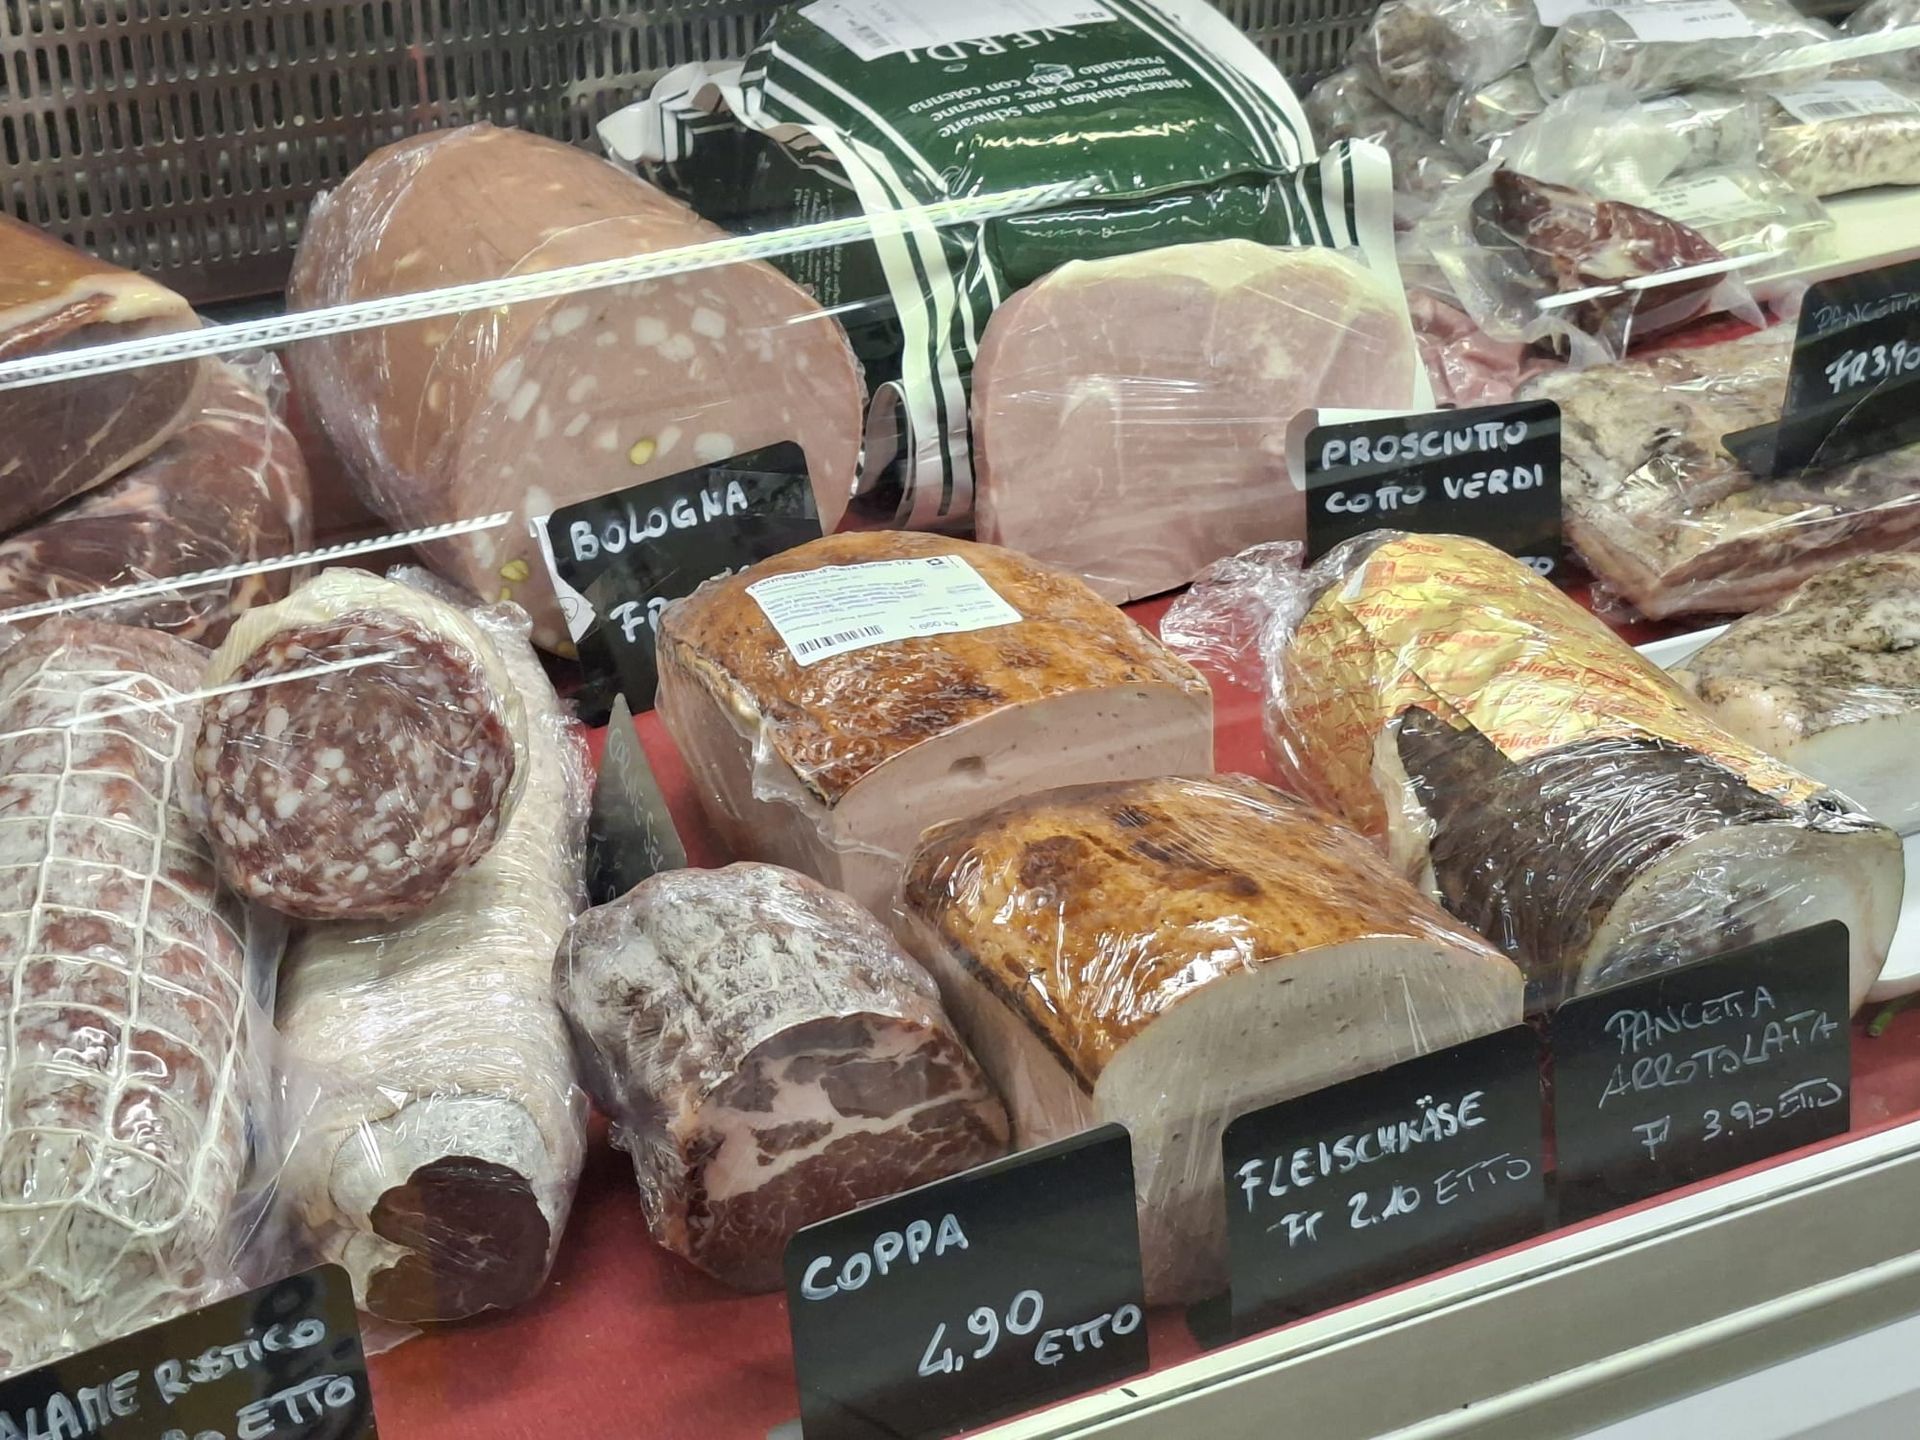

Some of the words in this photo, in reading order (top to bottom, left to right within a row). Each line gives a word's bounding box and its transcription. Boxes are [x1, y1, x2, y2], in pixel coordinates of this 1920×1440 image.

[986, 79, 1021, 92] con
[1078, 56, 1165, 75] Prosciutto
[908, 87, 982, 113] cotenna
[930, 95, 1010, 121] couenne
[1014, 87, 1057, 99] avec
[1024, 100, 1057, 113] mit
[1060, 78, 1192, 104] Hinterschinken
[938, 106, 1022, 137] Schwarte
[1321, 421, 1528, 470] PROSCIUTTO
[1325, 485, 1426, 513] COTTO
[1443, 463, 1544, 500] VERDI
[569, 481, 749, 562] BOLOGNA
[1604, 986, 1776, 1054] PANCETTA
[1234, 1090, 1487, 1213] FLEISCHKÄSE
[1434, 1153, 1531, 1205] ETTO
[801, 1213, 969, 1300] COPPA
[1034, 1303, 1142, 1366] ETTO
[0, 1369, 140, 1440] ALAME
[236, 1374, 356, 1440] ETTO
